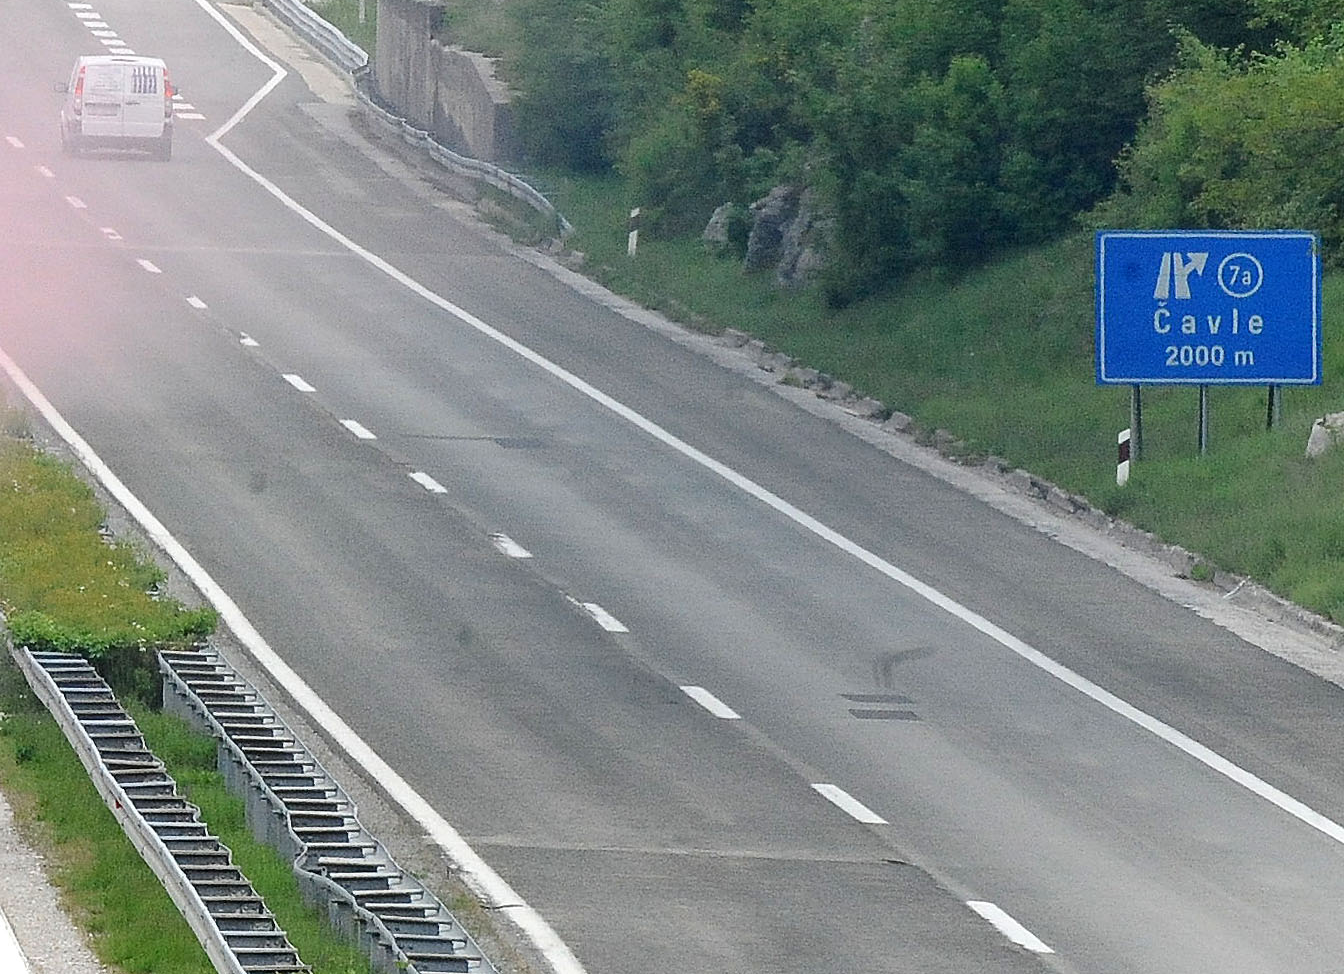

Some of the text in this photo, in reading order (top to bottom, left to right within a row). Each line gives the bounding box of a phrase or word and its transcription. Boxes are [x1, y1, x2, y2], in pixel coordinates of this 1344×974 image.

[1228, 265, 1252, 286] 7a
[1153, 300, 1264, 335] Čavle
[1165, 345, 1255, 367] 2000 m
